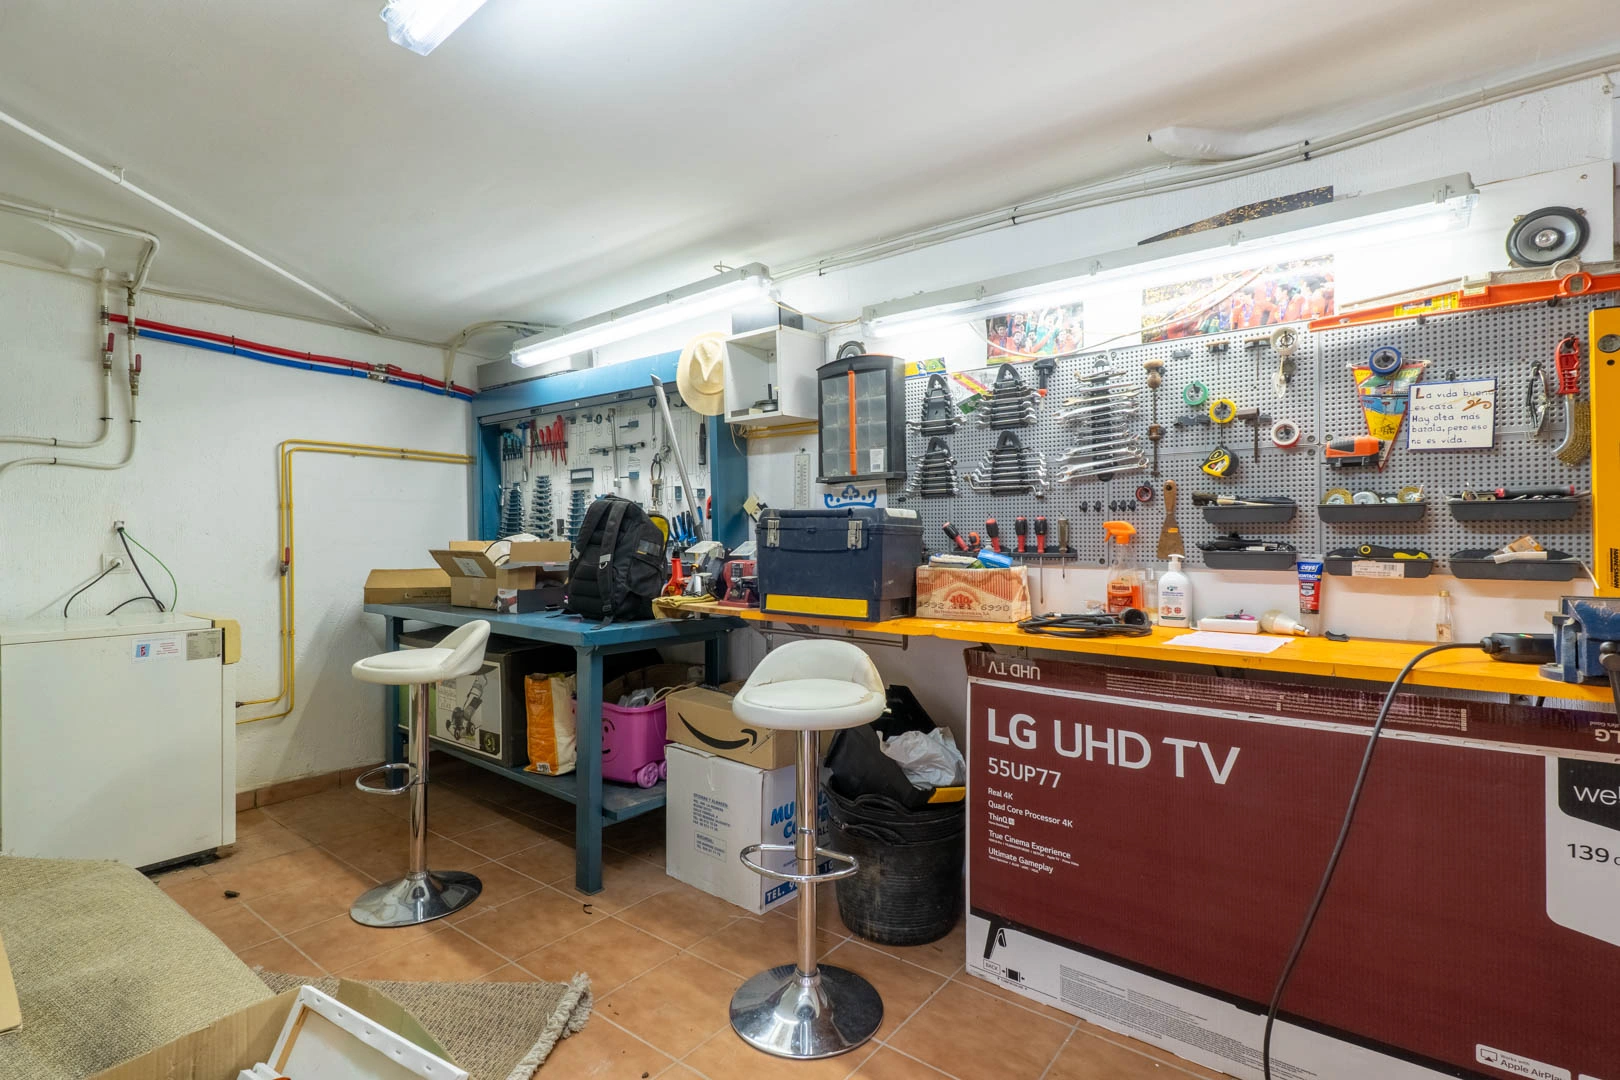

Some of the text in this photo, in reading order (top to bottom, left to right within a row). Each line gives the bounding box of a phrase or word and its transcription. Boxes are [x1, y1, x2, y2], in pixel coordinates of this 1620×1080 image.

[1416, 387, 1432, 399] La
[1437, 388, 1458, 397] vida
[1412, 415, 1430, 425] Hay
[1433, 412, 1454, 421] otra
[1447, 425, 1468, 435] pero
[988, 661, 1041, 681] UHD TV
[988, 707, 1241, 785] LG UHD TV
[988, 757, 1061, 788] 55UP77
[988, 787, 1014, 800] Real 4K
[1573, 784, 1620, 806] we
[988, 800, 1006, 811] Quad
[1006, 805, 1023, 815] Core
[1024, 809, 1060, 825] Processor
[1062, 819, 1073, 828] 4K
[988, 812, 1009, 824] ThinQ
[988, 829, 1003, 840] True
[1004, 834, 1030, 848] Cinema
[1031, 841, 1071, 859] Experience
[1567, 843, 1609, 863] 139
[988, 847, 1018, 862] Ultimate
[1018, 856, 1054, 874] Gameplay
[766, 887, 785, 902] TEL.
[1500, 1059, 1529, 1074] Apple
